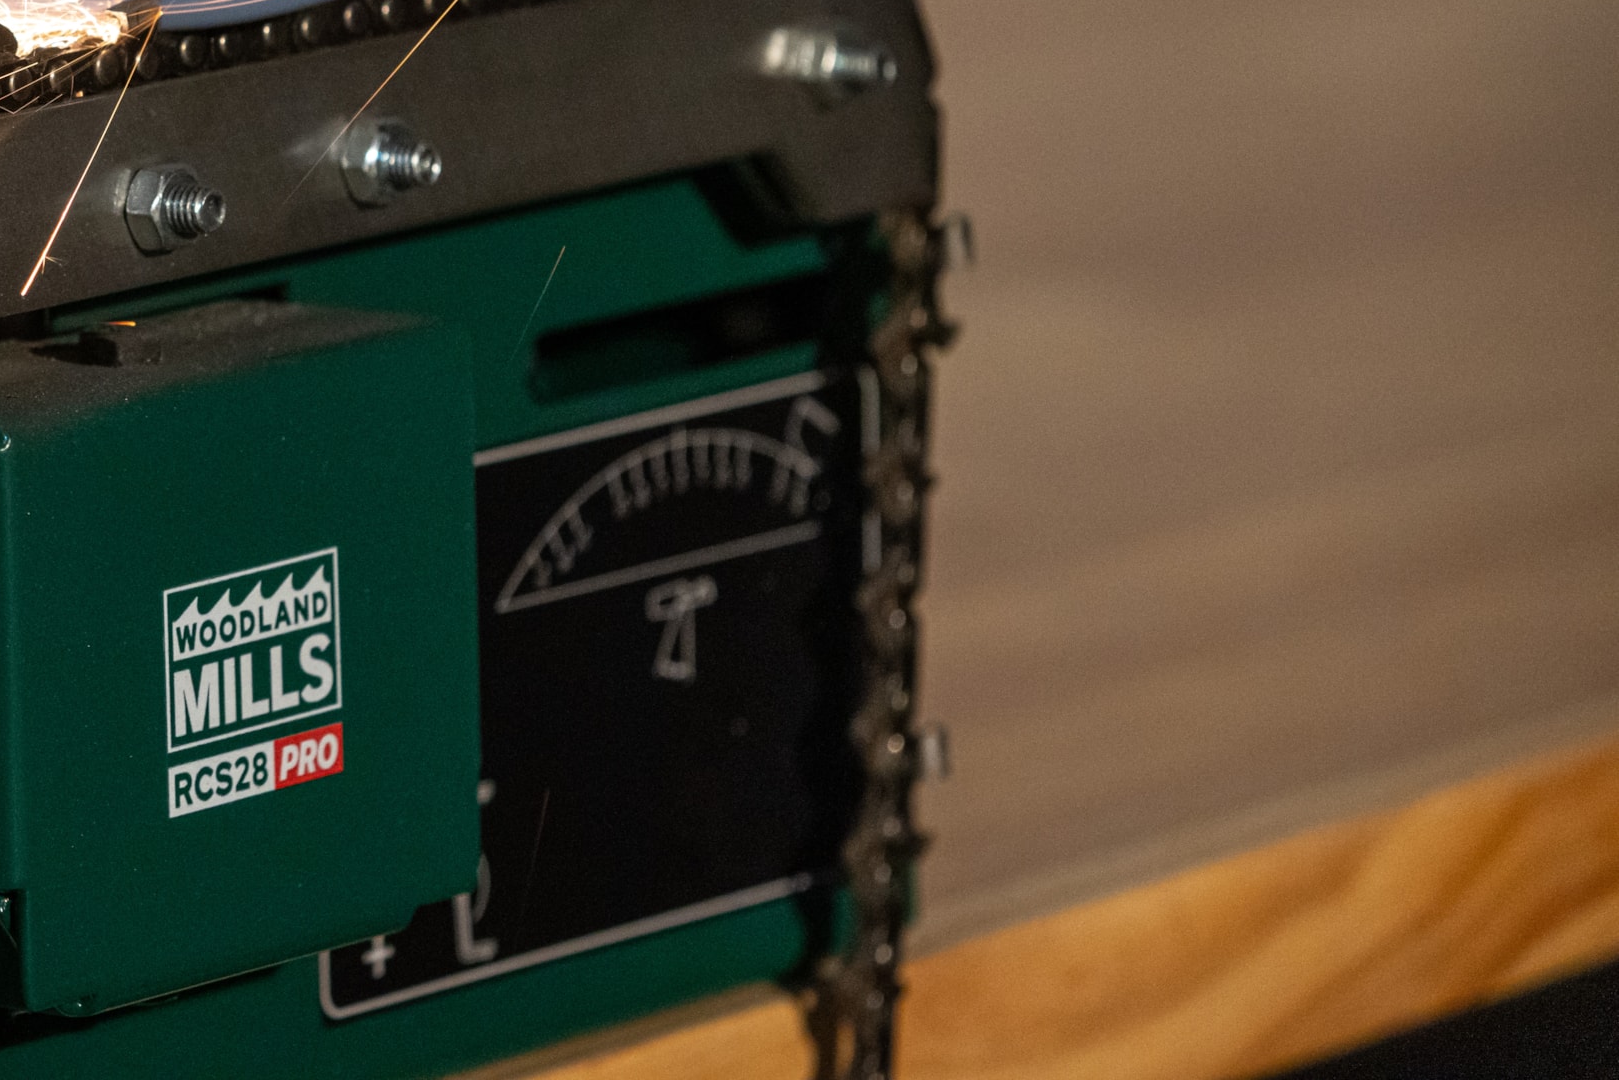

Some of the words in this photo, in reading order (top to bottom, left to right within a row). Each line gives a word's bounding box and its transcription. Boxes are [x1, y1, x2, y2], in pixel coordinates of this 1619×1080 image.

[175, 590, 329, 654] WOODLAND
[173, 632, 335, 738] MILLS
[174, 751, 269, 809] RCS28
[279, 732, 339, 782] PRO
